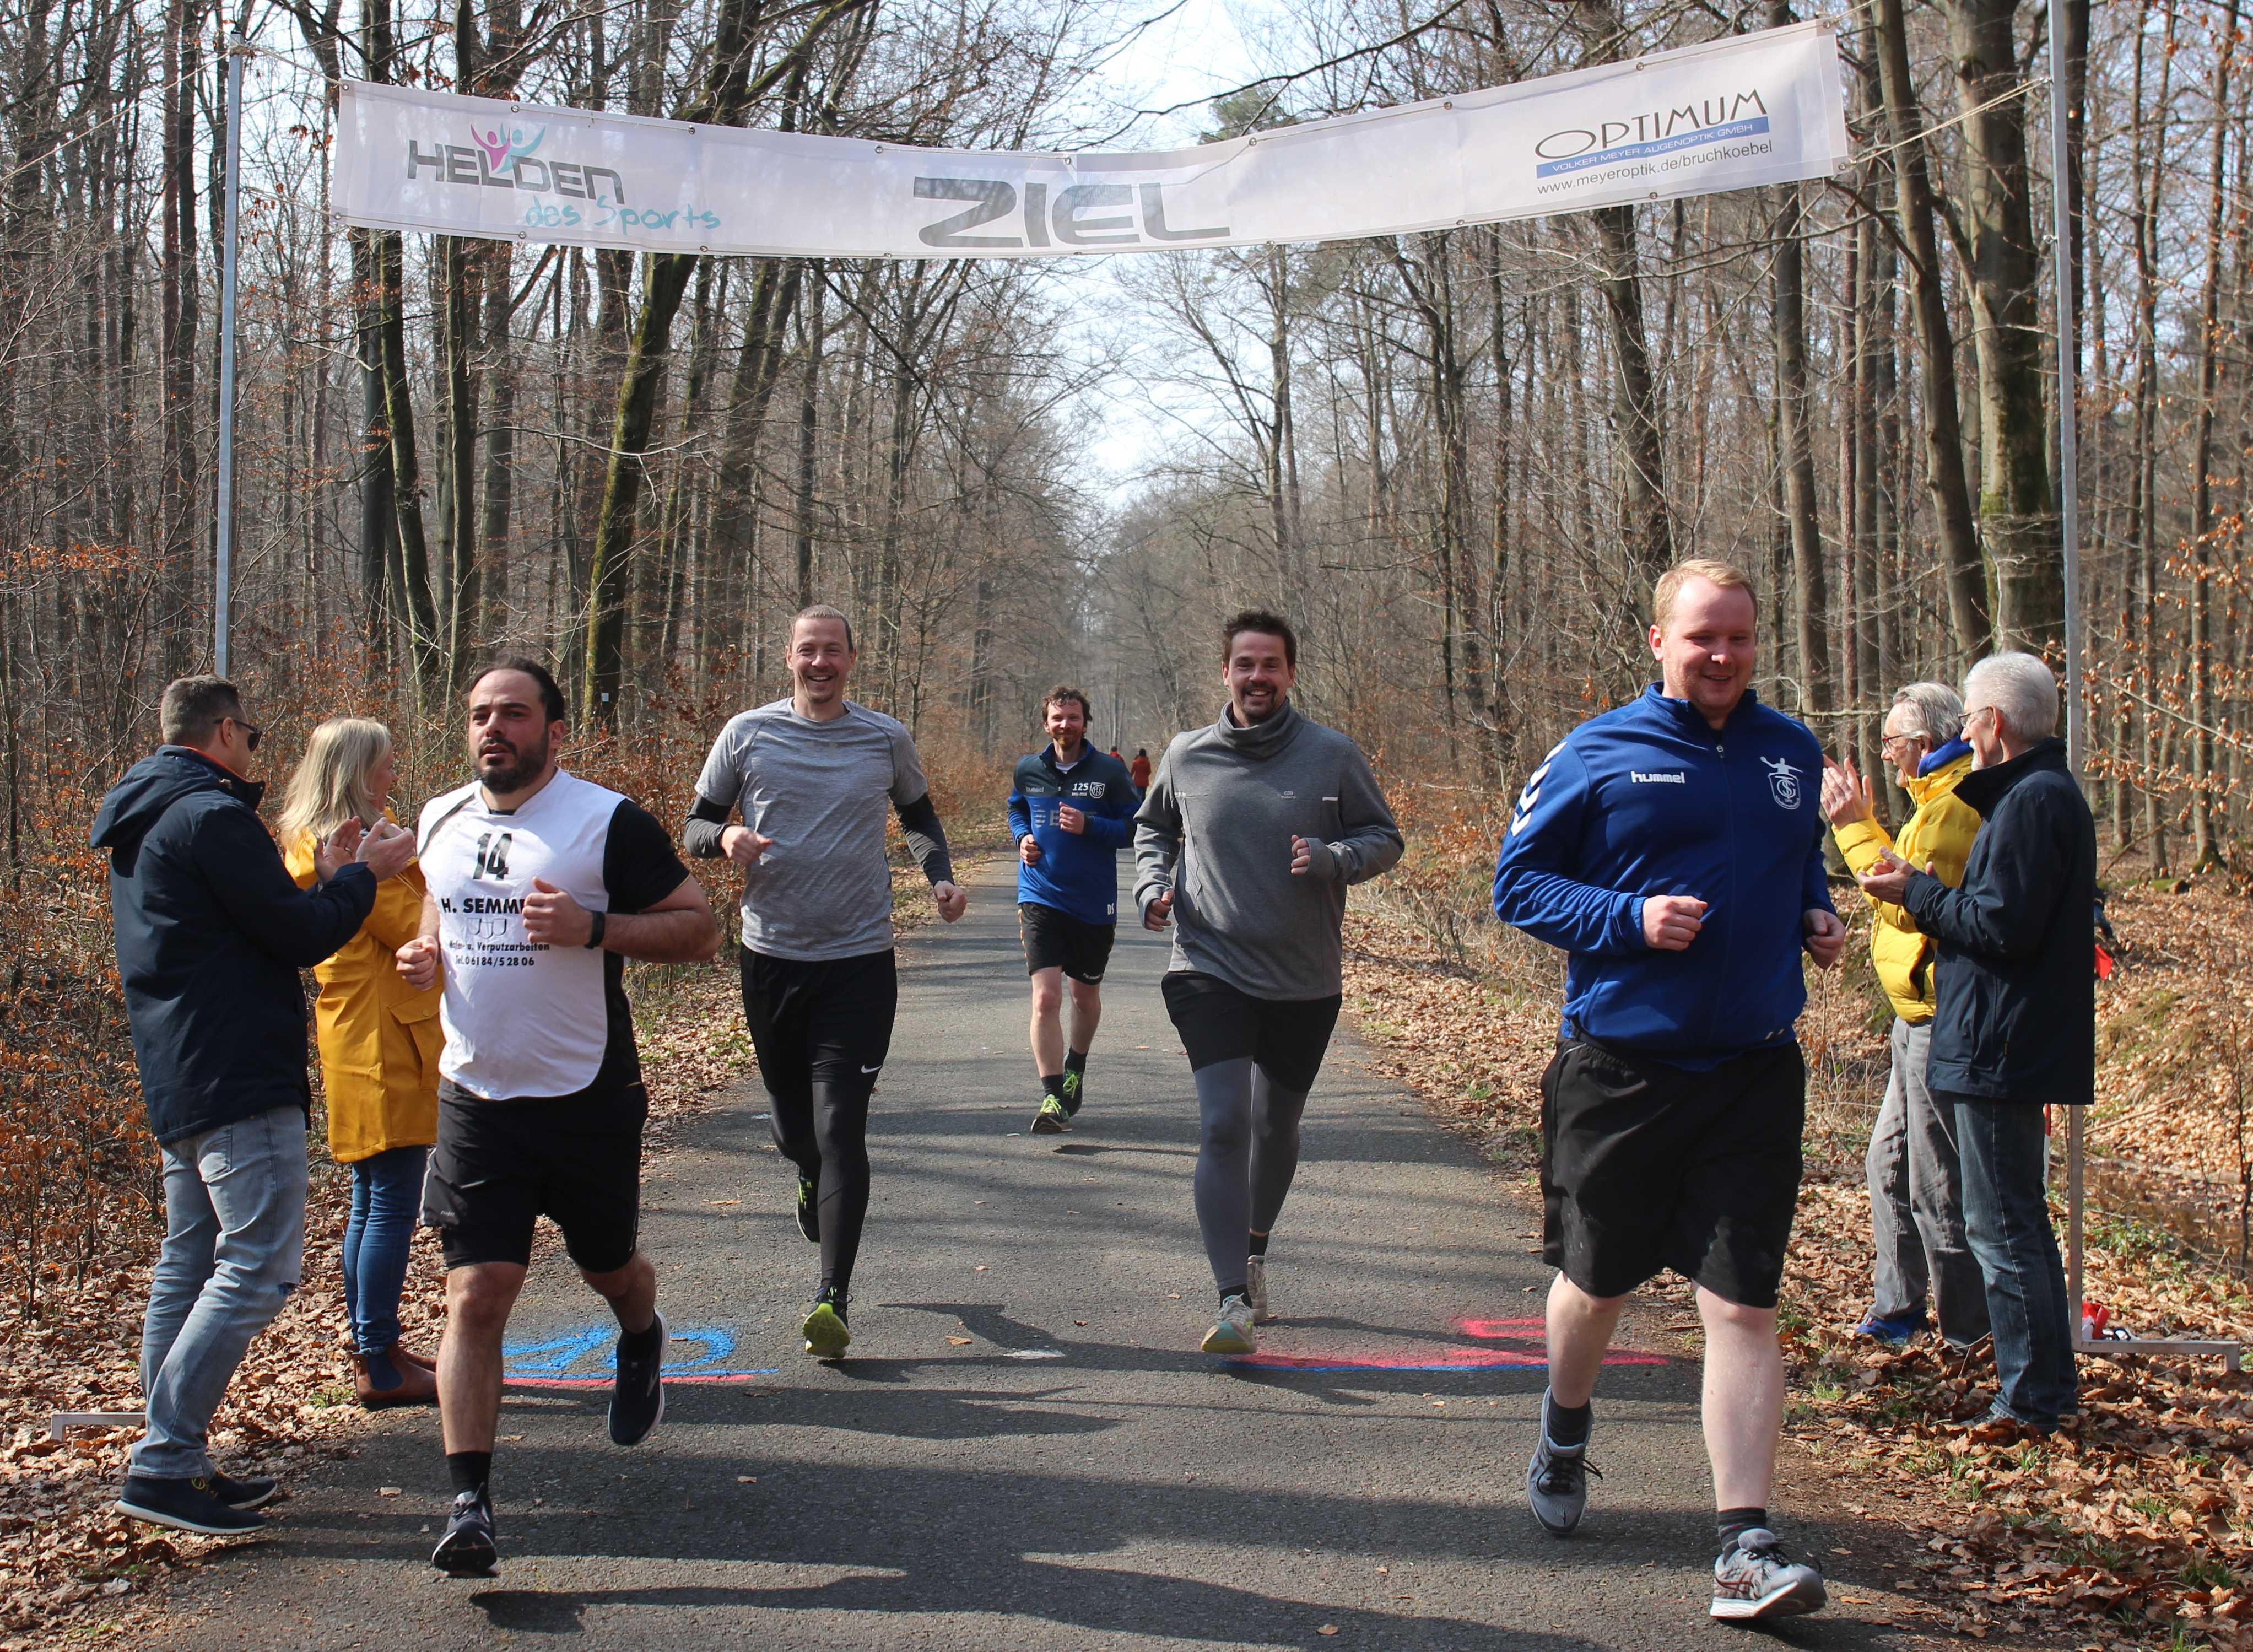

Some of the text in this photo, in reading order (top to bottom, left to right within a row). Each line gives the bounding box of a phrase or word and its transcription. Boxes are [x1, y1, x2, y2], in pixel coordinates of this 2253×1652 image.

[1535, 89, 1768, 159] OPTIMUM
[1536, 139, 1773, 195] www.meyeroptik.de/bruchkoebel
[1552, 123, 1754, 172] VOLKER MEYER AUGENOPTIK GMBH
[525, 195, 721, 235] des Sports
[913, 176, 1230, 248] ZIEL
[1072, 782, 1089, 791] 125
[1630, 770, 1685, 785] hummel
[472, 833, 512, 881] 14
[441, 898, 457, 914] H.
[1107, 903, 1115, 916] DS
[477, 942, 550, 953] Verputzarbeiten
